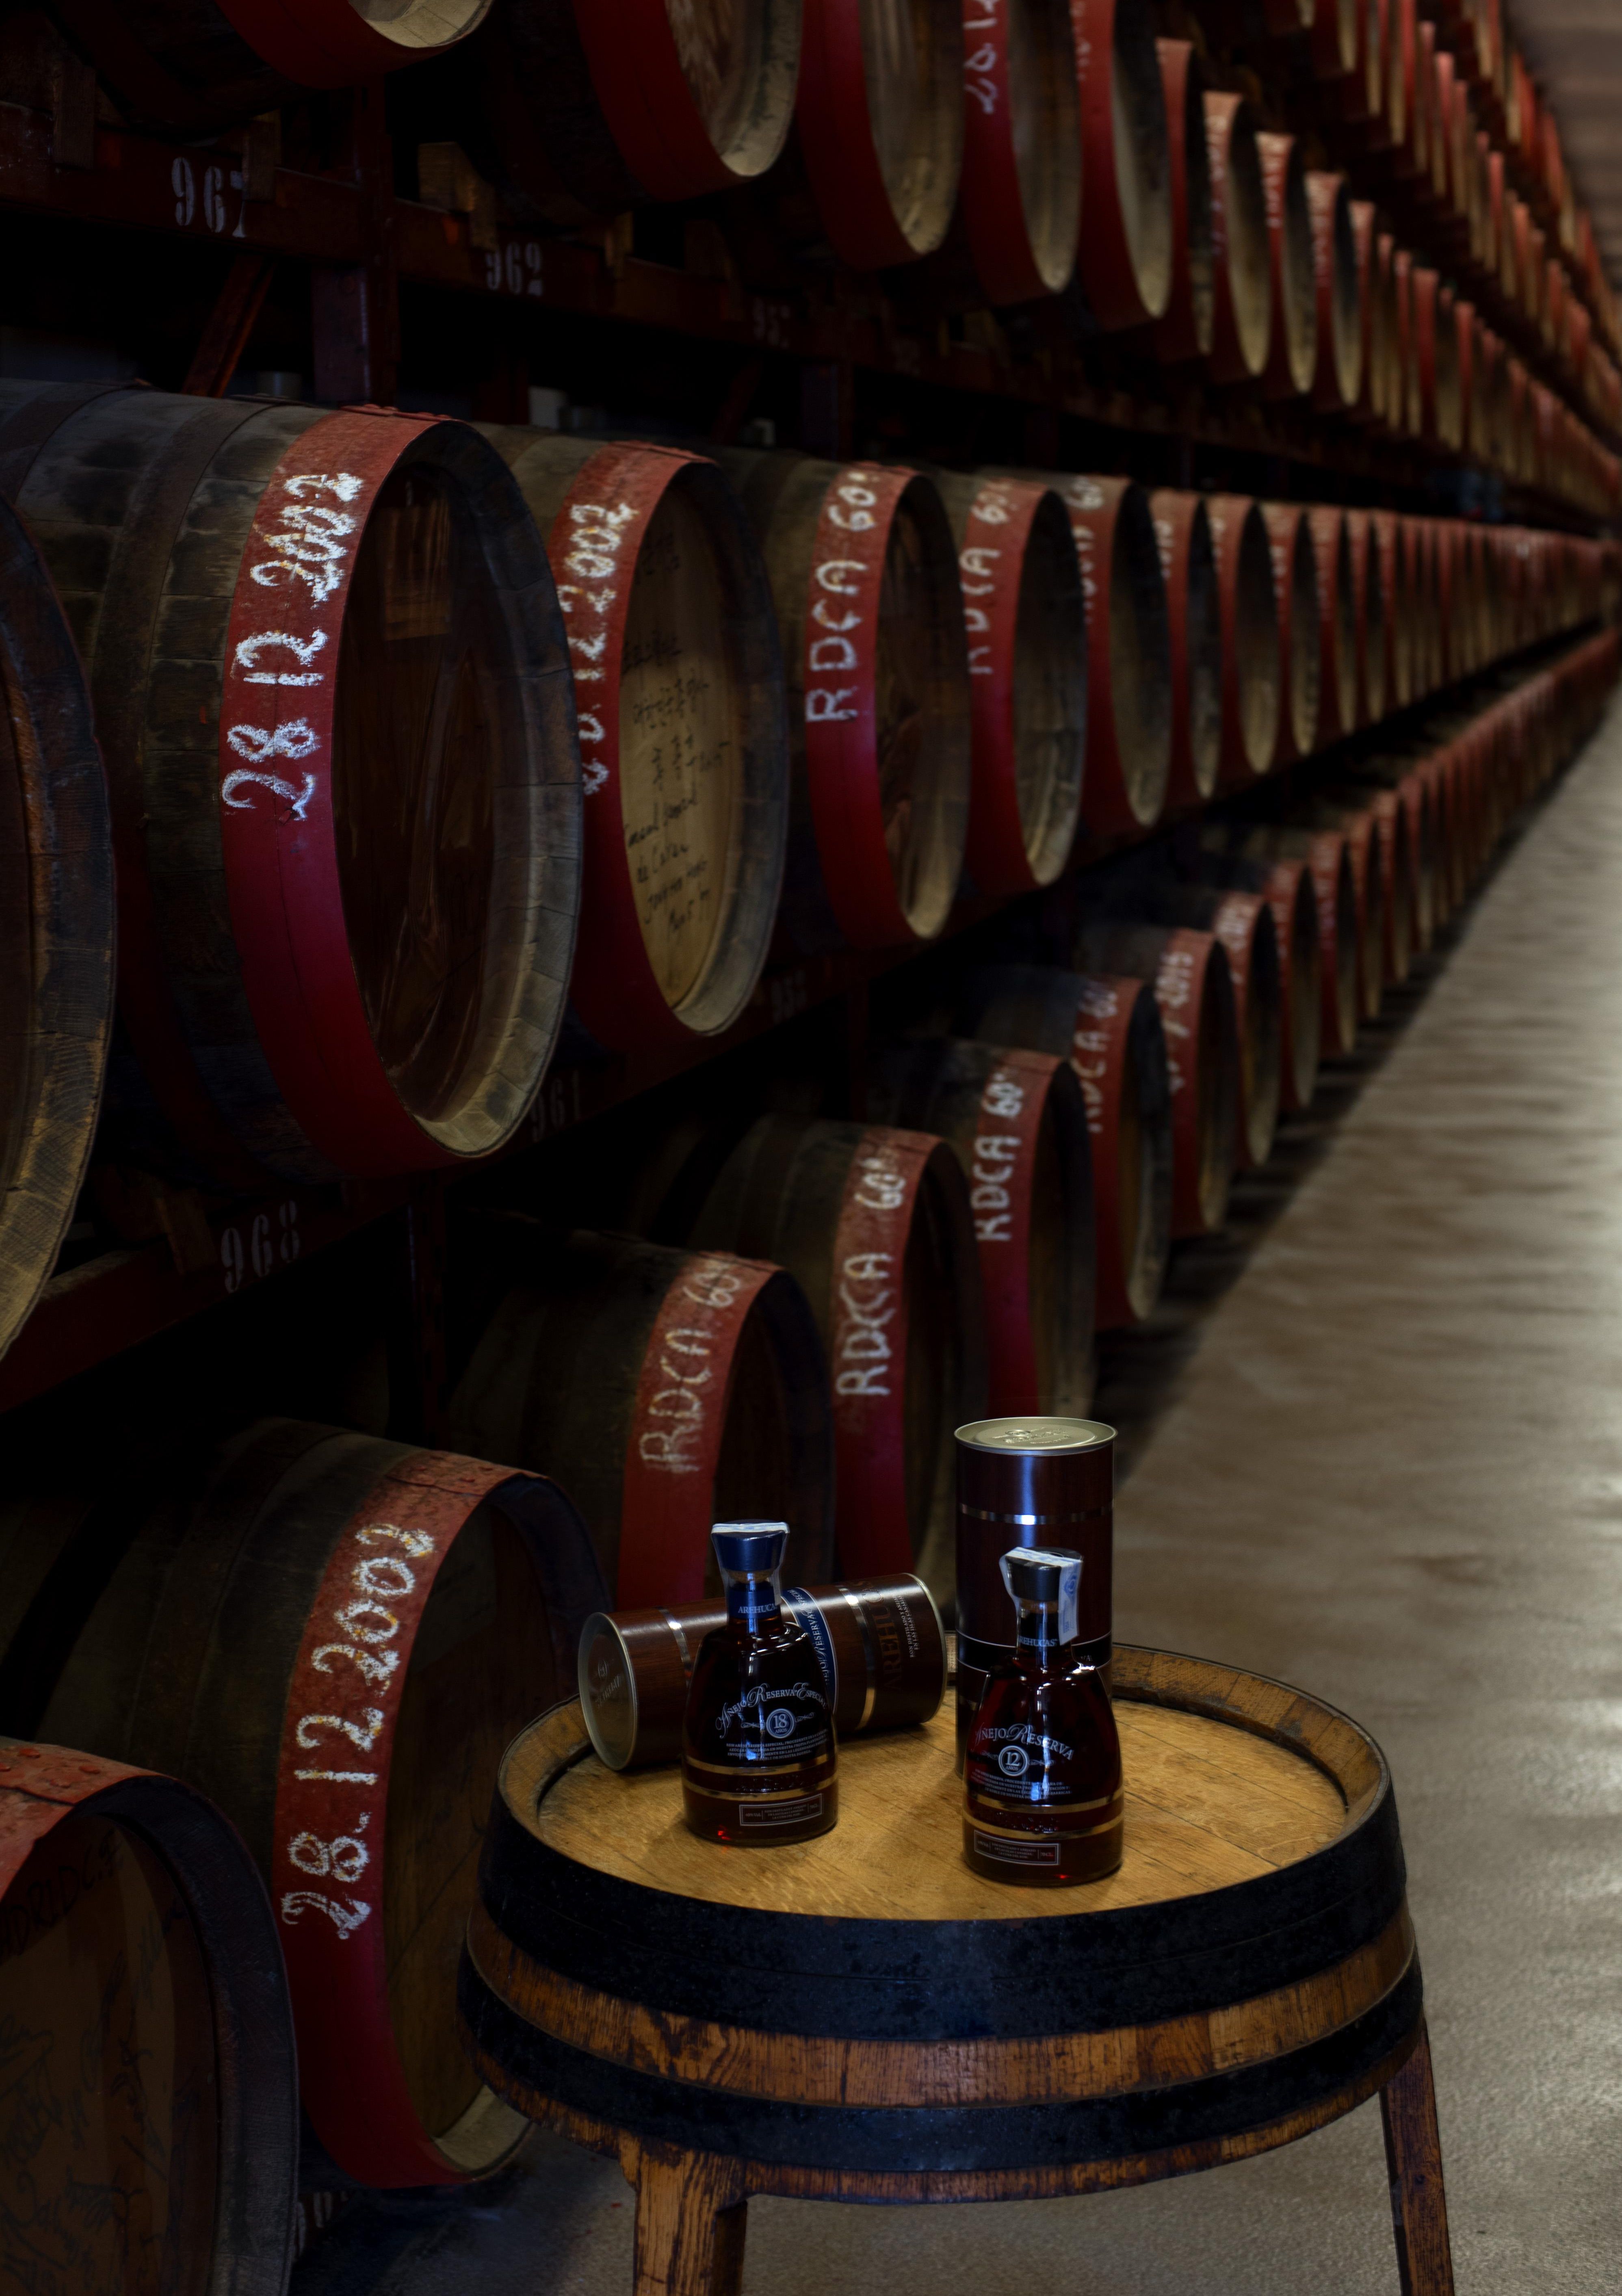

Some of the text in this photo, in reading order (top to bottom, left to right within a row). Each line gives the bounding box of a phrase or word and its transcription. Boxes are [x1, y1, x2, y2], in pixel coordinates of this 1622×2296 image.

[222, 717, 322, 821] 28
[221, 1199, 301, 1294] 968
[901, 1615, 912, 1644] DESTILADO
[1018, 1636, 1056, 1647] REHUCAS
[773, 1713, 788, 1729] 18
[1006, 1723, 1075, 1761] RESERVA
[1005, 1751, 1022, 1766] 12
